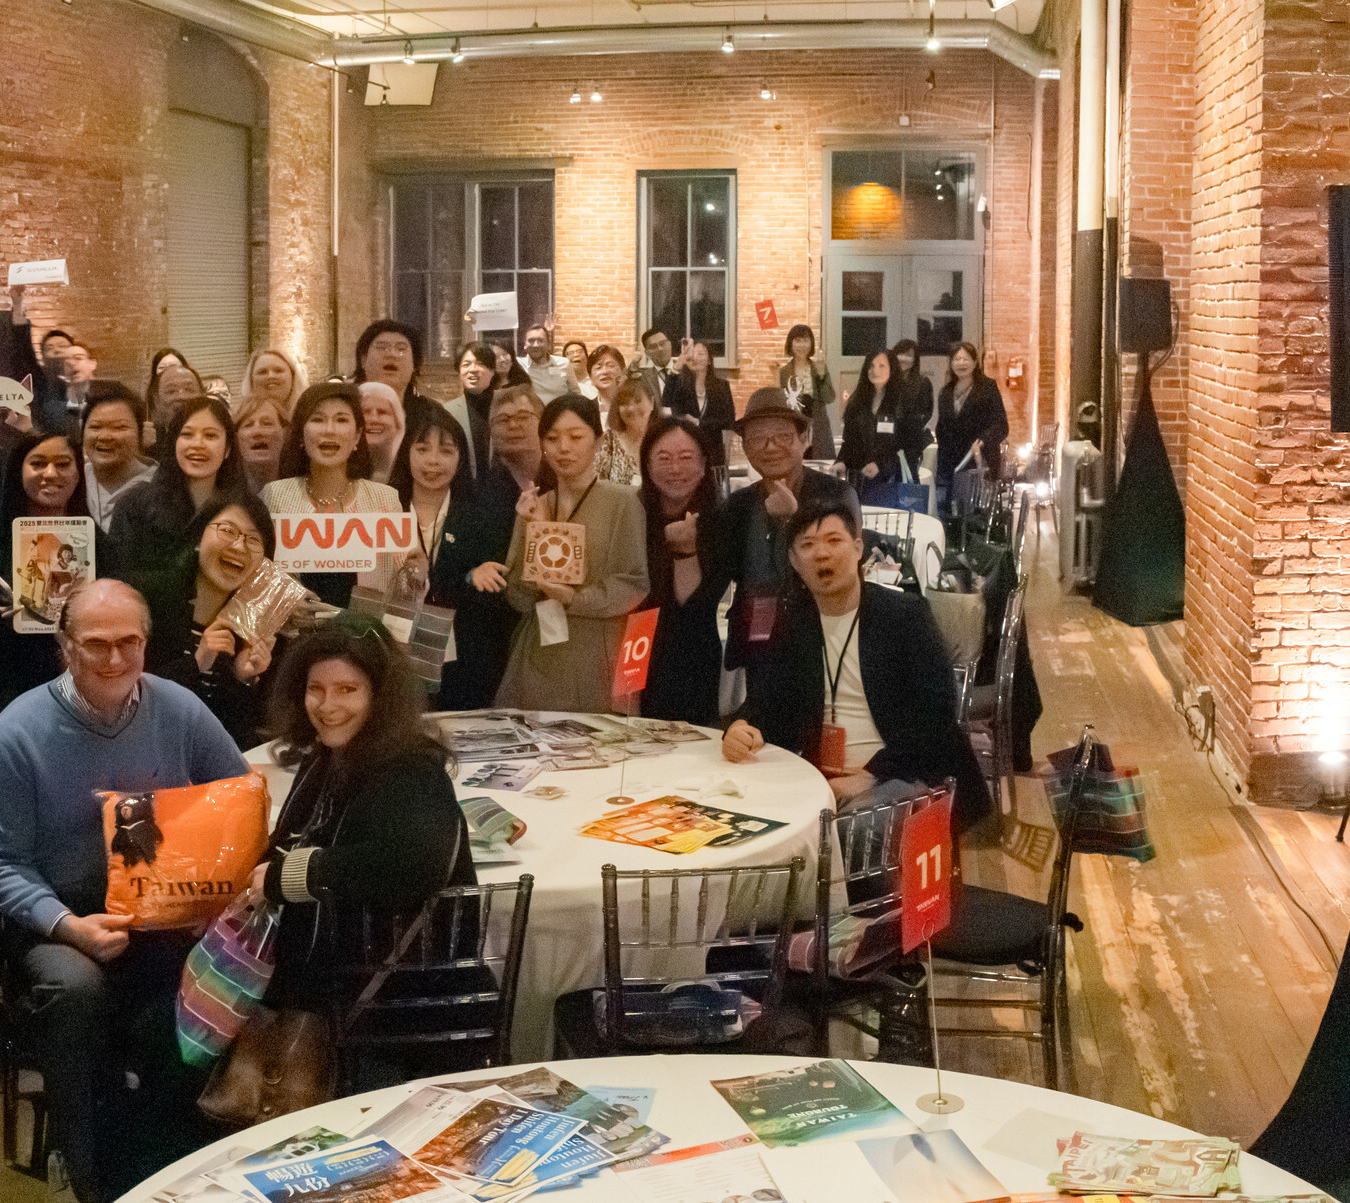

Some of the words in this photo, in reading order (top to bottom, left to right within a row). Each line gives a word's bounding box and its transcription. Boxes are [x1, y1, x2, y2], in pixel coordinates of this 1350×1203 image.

[759, 306, 772, 321] 7
[293, 560, 310, 569] OF
[314, 560, 373, 569] WONDER
[623, 636, 650, 665] 10
[915, 843, 942, 890] 11
[129, 876, 235, 898] Taiwan
[498, 1113, 524, 1126] Day
[796, 1112, 857, 1127] TAIWAN
[479, 1127, 507, 1145] Tour
[538, 1144, 596, 1167] Houton
[560, 1149, 607, 1168] Jiufen
